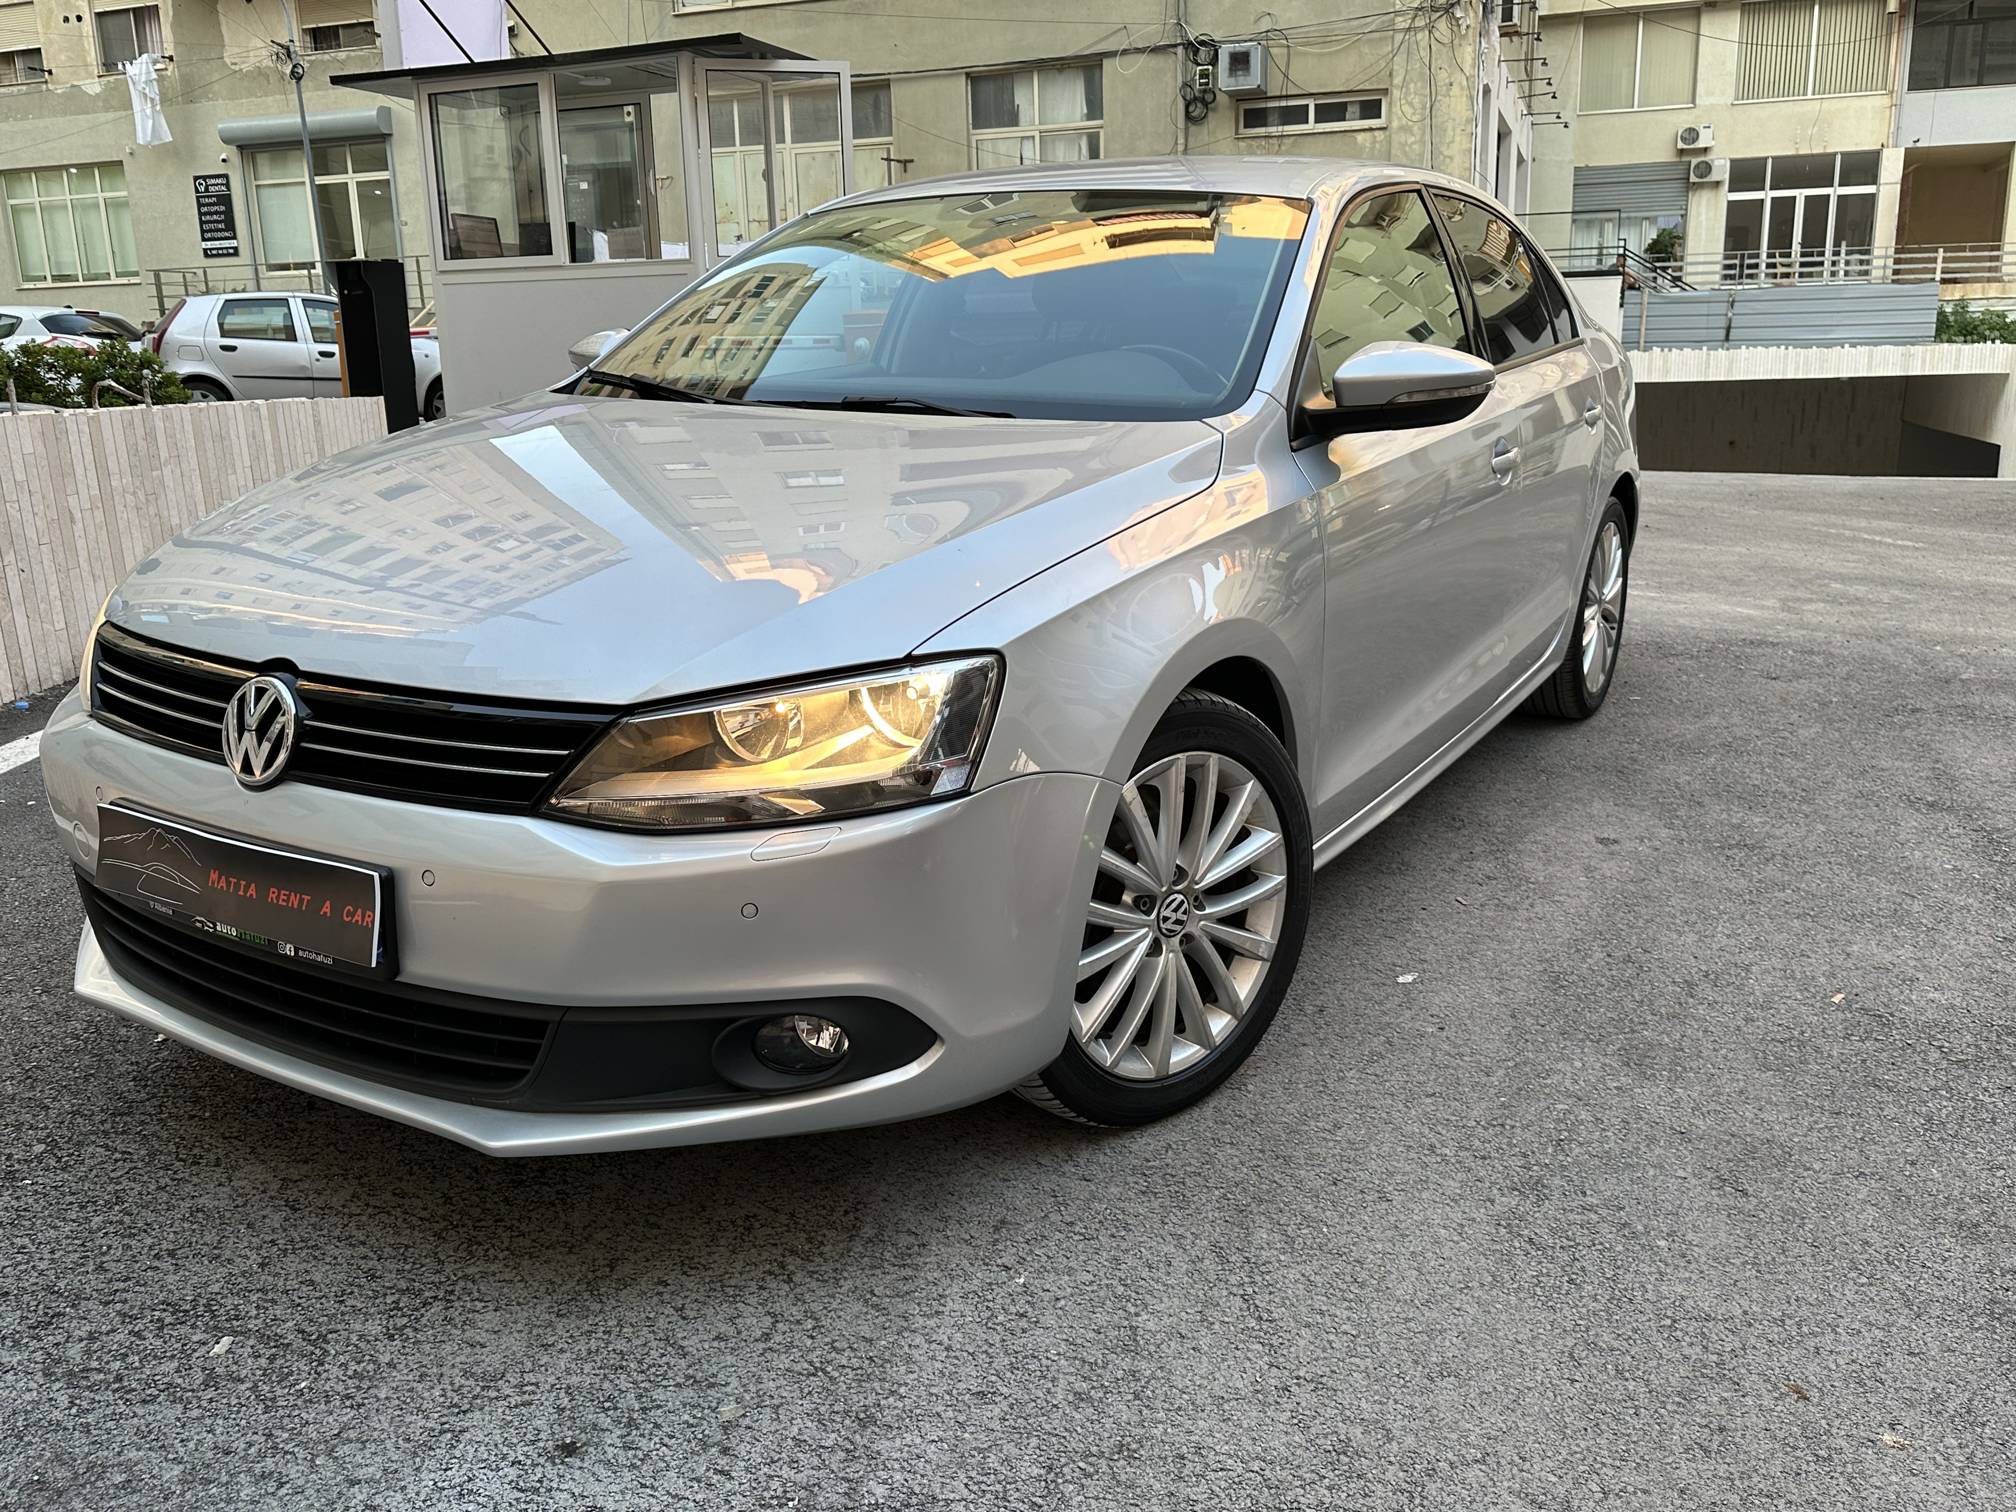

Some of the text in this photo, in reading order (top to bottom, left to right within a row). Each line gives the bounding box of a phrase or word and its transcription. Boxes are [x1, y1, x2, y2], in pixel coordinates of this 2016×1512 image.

[200, 205, 226, 213] ORTOPEDI
[223, 677, 294, 784] VW
[208, 869, 374, 928] MATIA RENT A CAR
[1158, 893, 1189, 936] VW
[298, 949, 333, 965] autohafuzi
